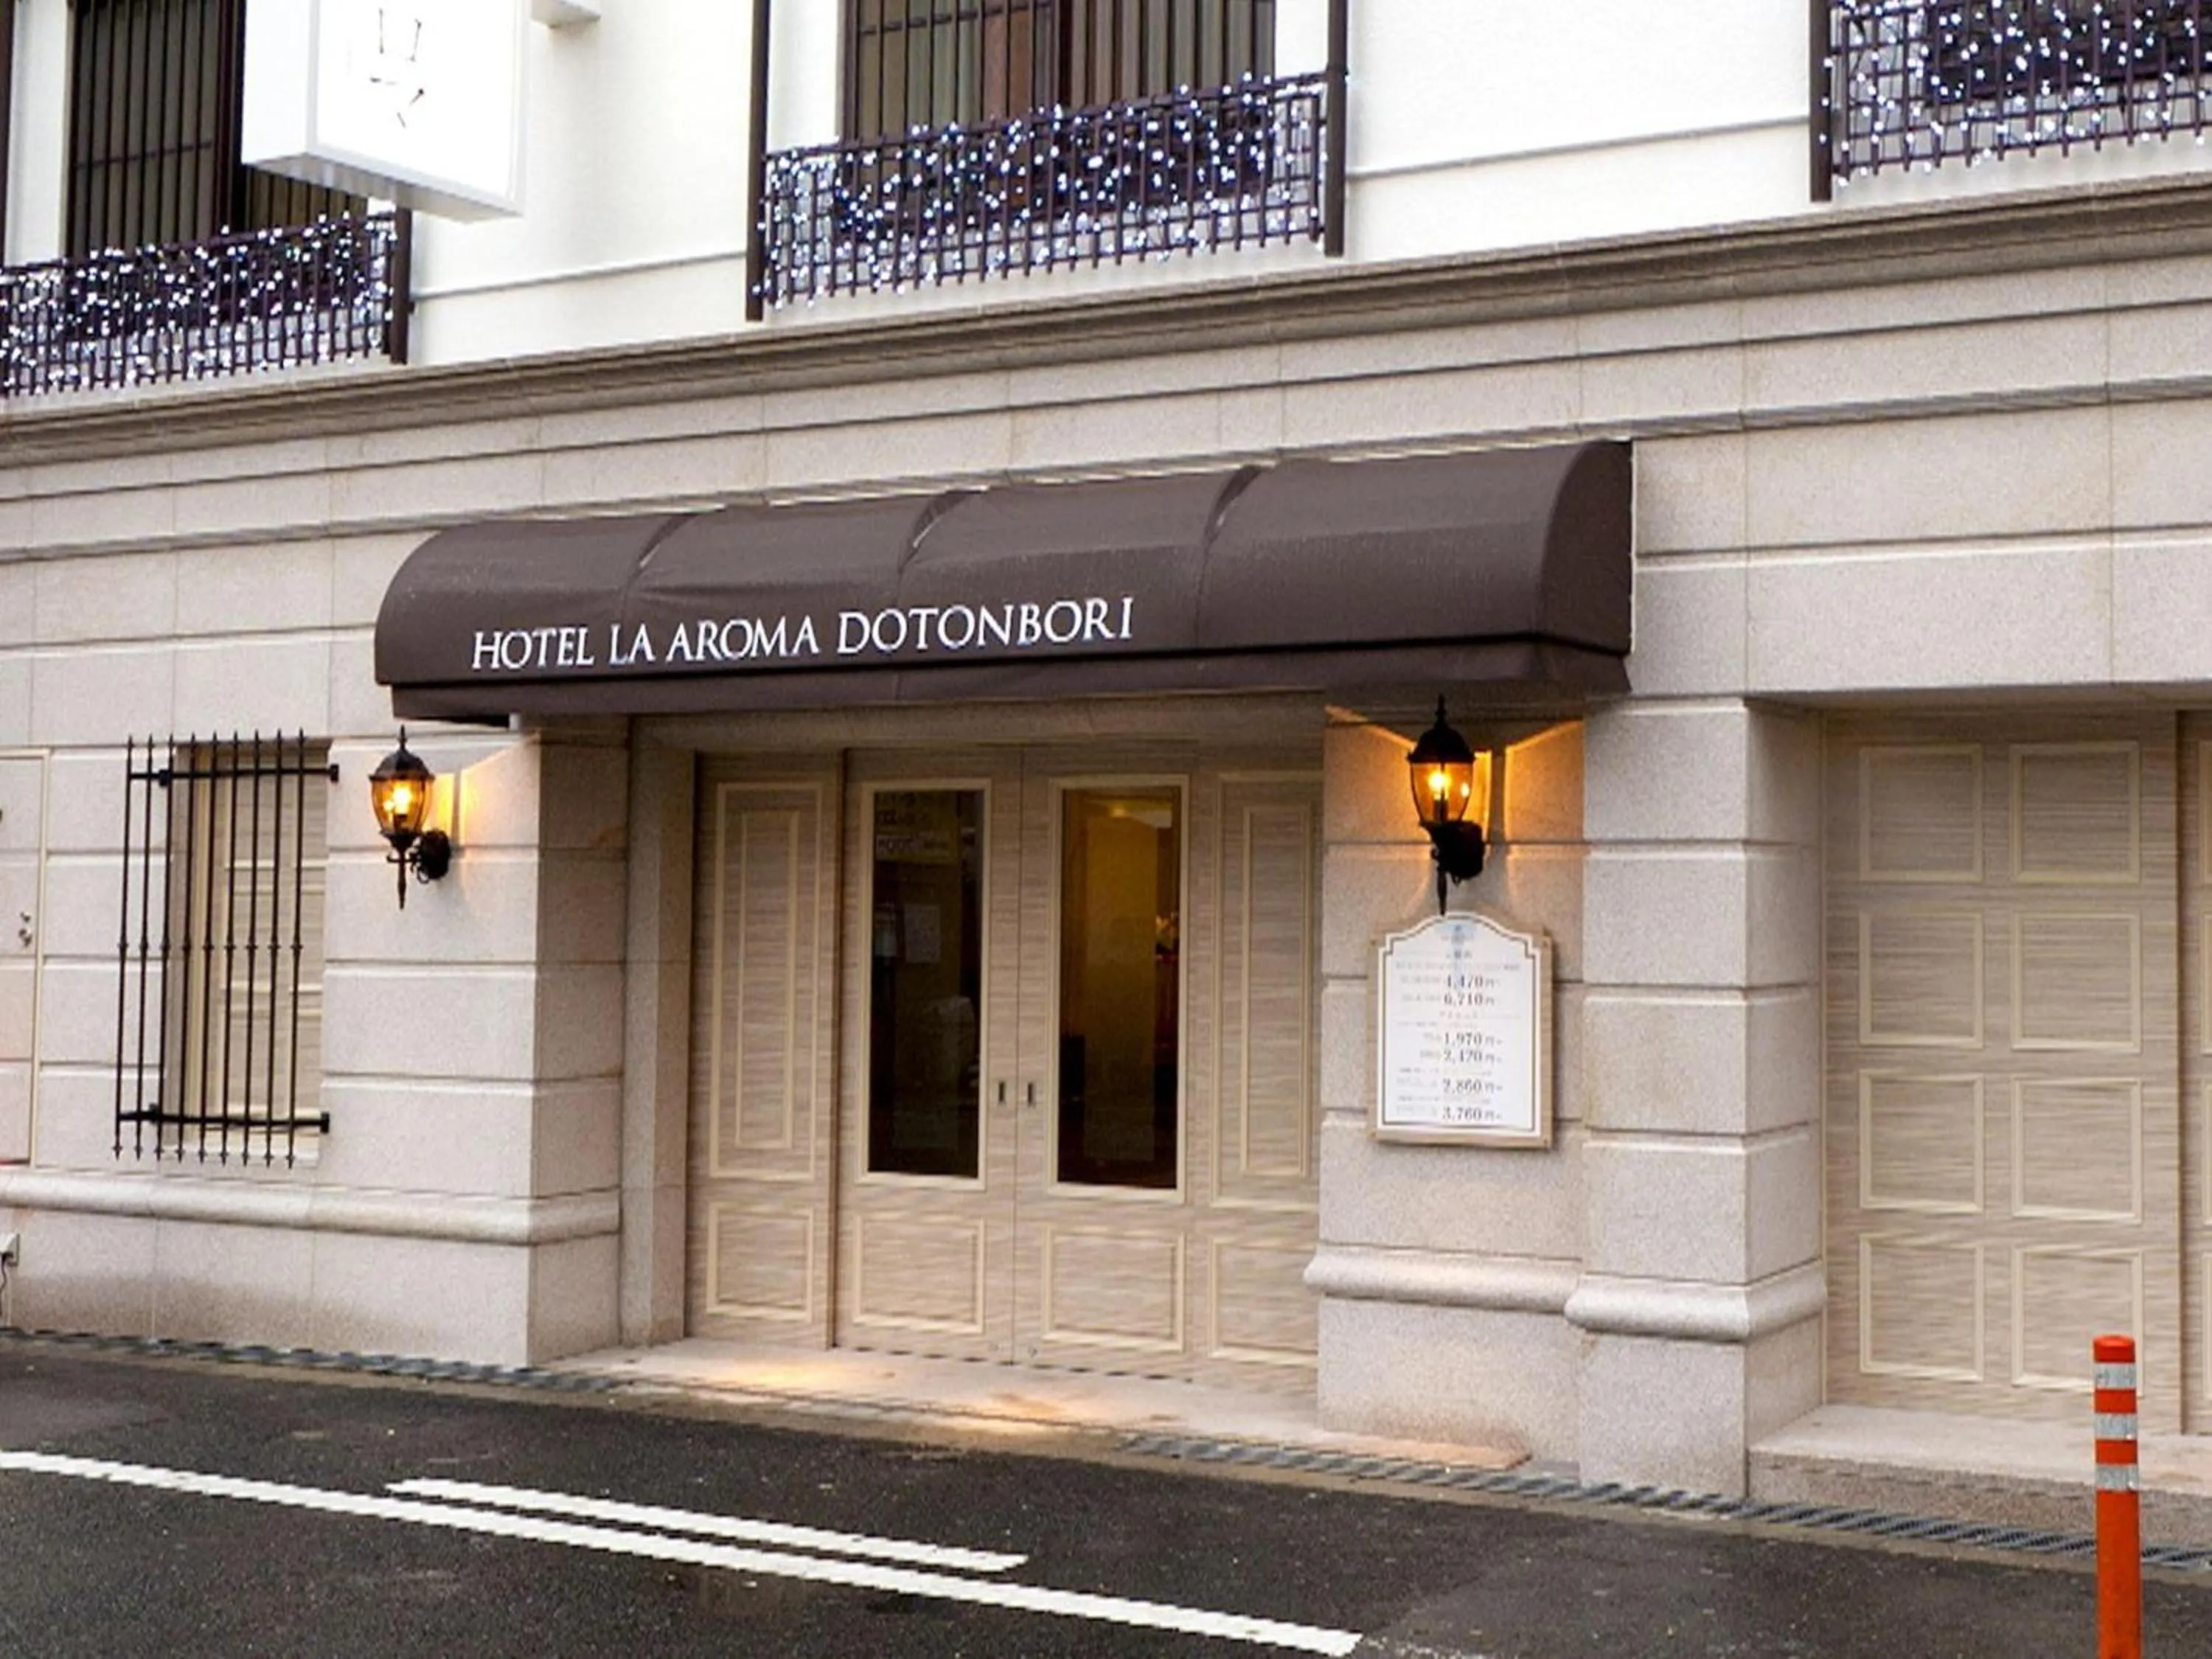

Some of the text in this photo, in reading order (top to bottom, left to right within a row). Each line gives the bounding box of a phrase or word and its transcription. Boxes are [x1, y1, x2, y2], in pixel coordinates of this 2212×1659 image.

[472, 597, 1134, 669] HOTEL LA AROMA DOTONBORI
